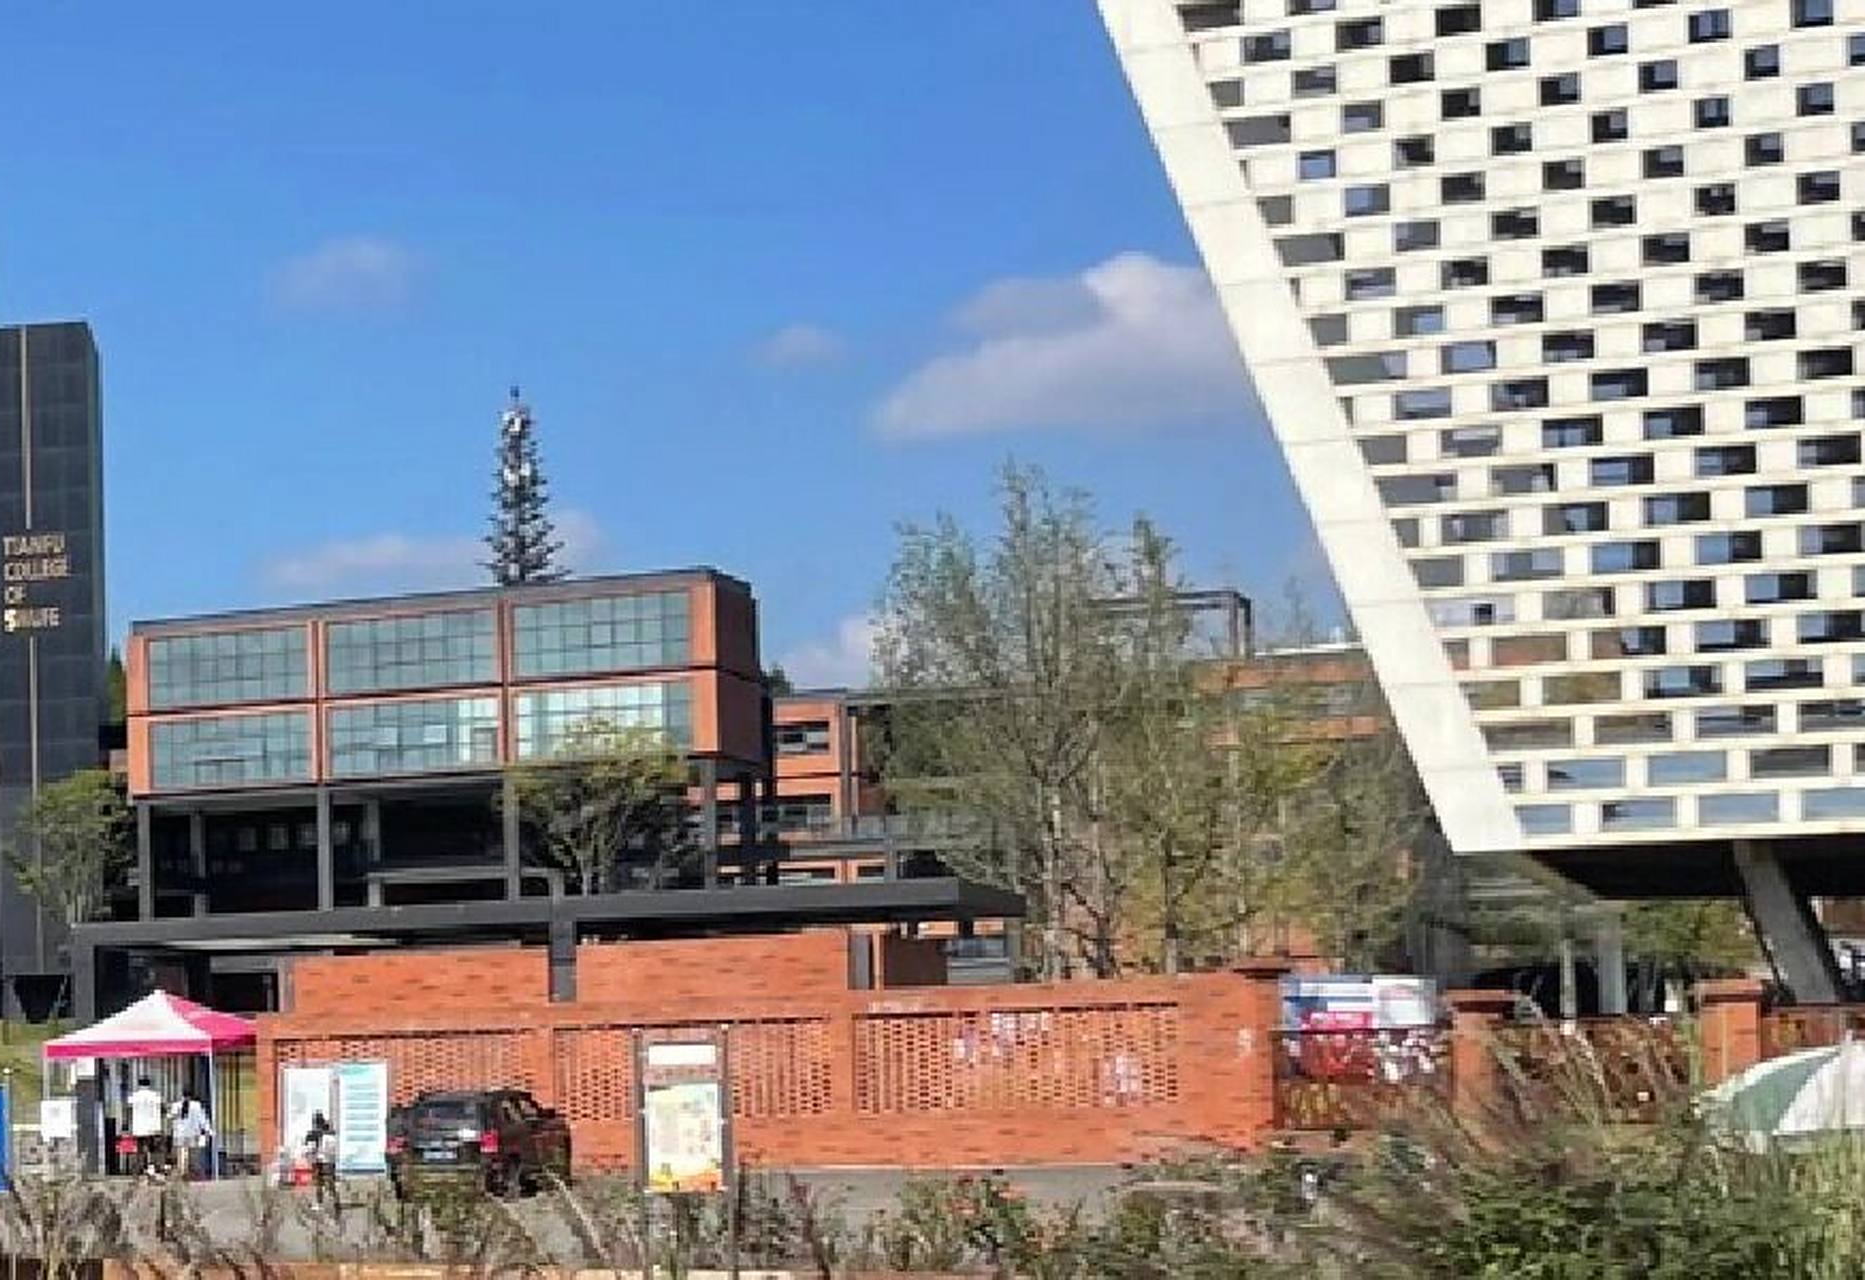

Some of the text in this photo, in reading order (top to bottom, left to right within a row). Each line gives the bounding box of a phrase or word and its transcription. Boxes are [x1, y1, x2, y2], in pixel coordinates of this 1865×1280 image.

[2, 534, 65, 556] TIANFU
[3, 558, 68, 581] COLLEGE
[3, 586, 26, 604] OF
